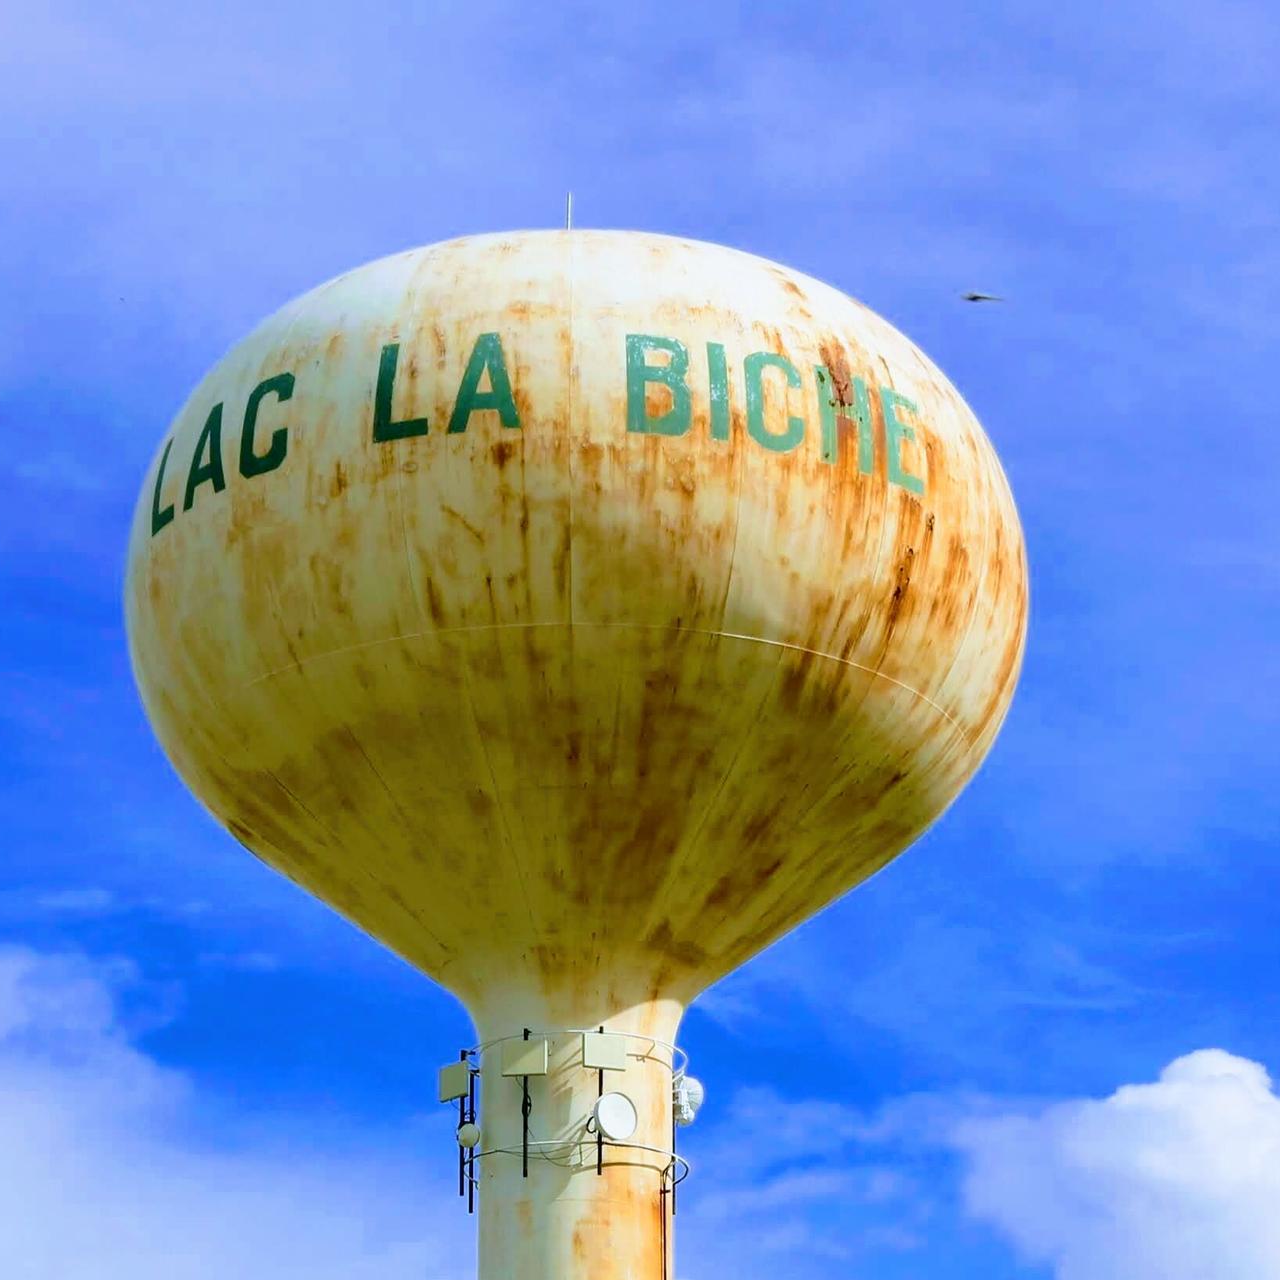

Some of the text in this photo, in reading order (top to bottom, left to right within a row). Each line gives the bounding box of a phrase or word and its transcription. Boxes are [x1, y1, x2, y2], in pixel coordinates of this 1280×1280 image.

[151, 332, 925, 537] LAC LA BICHE
